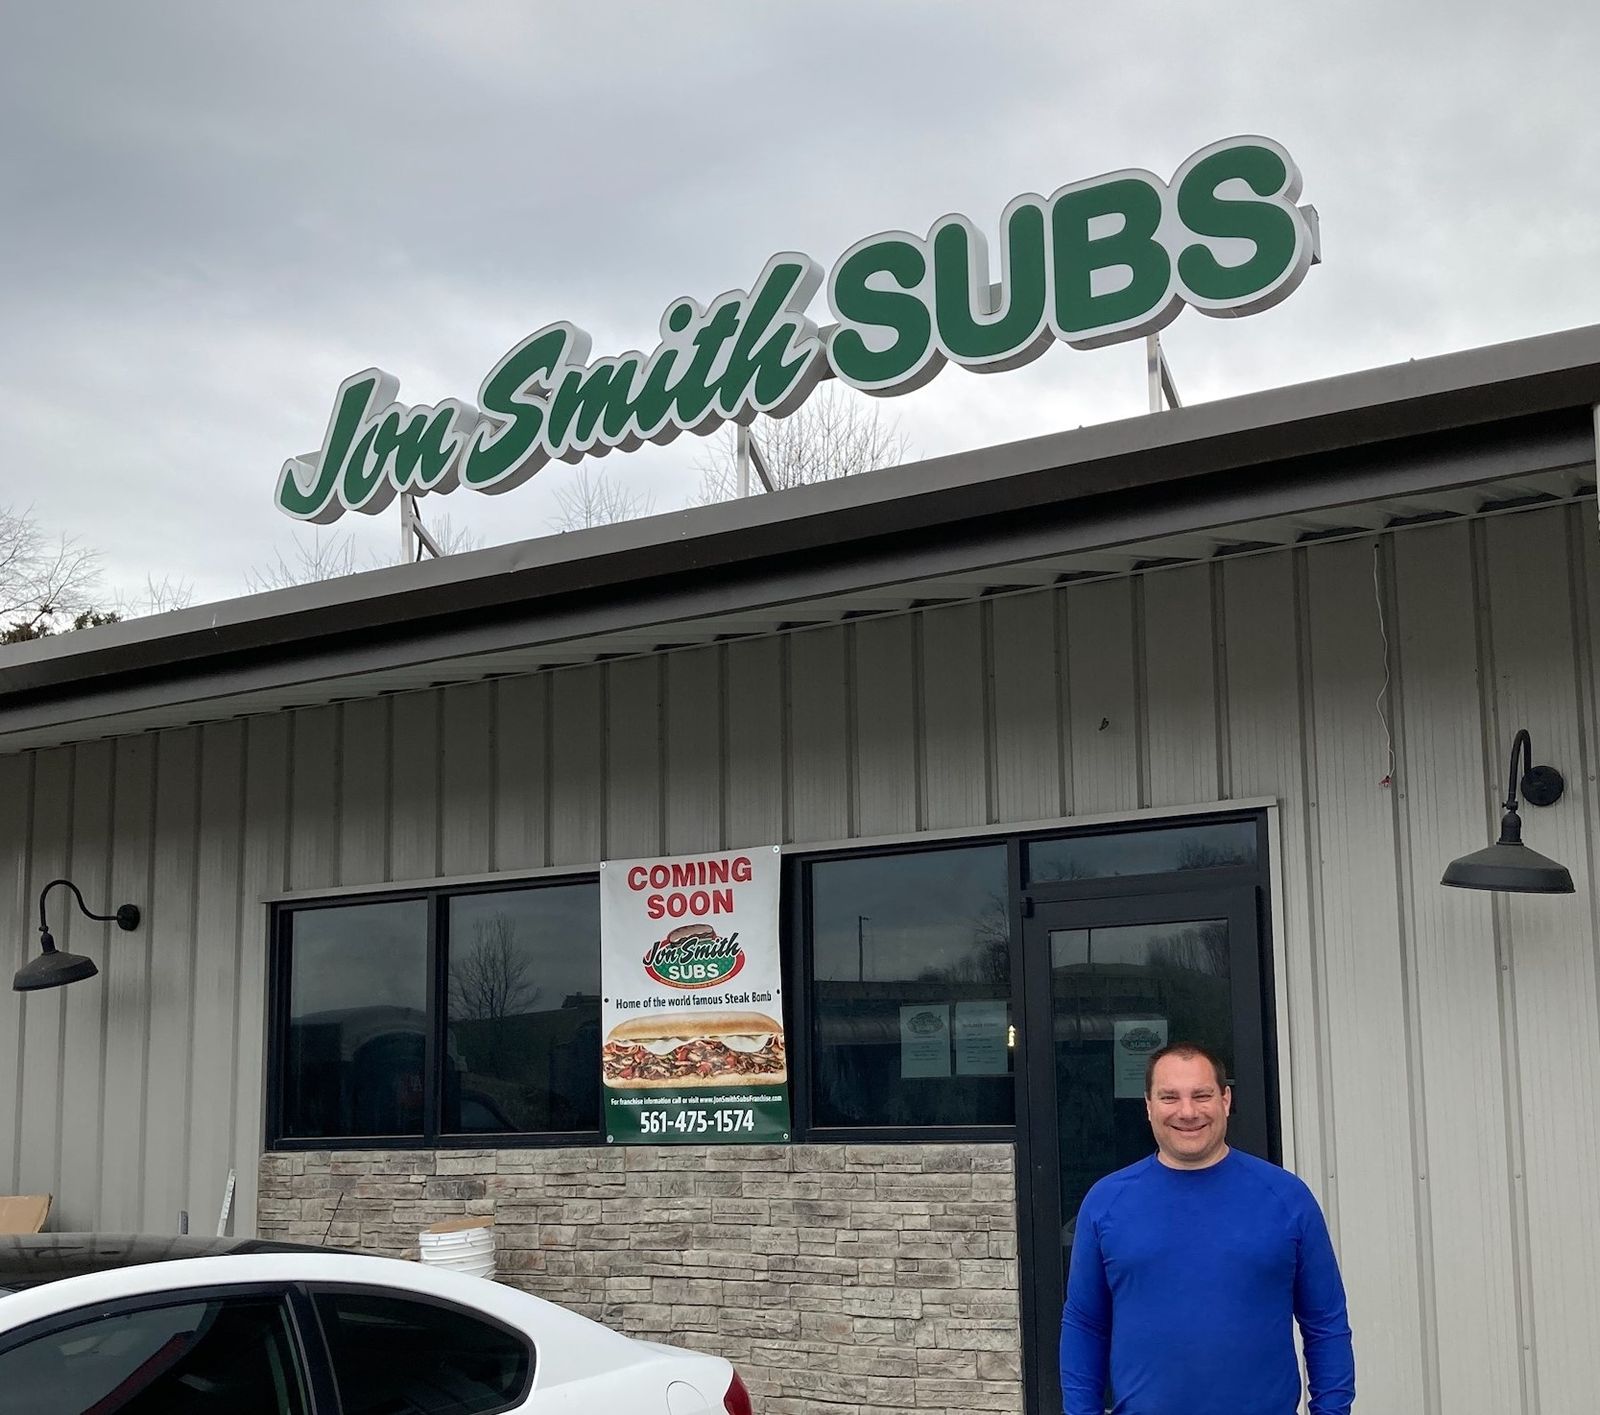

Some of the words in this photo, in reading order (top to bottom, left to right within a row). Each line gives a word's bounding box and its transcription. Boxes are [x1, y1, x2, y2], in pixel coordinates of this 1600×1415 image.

[278, 376, 457, 514] Jon
[466, 264, 810, 484] Smith
[829, 145, 1296, 383] SUBS
[627, 856, 753, 891] COMING
[647, 888, 734, 919] SOON
[642, 941, 678, 966] Jon
[679, 932, 742, 964] Smith
[668, 963, 720, 980] SUBS
[616, 999, 641, 1009] Home
[643, 997, 652, 1007] of
[653, 996, 666, 1007] the
[668, 995, 691, 1006] world
[693, 994, 723, 1005] famous
[724, 993, 750, 1004] Steak
[751, 990, 772, 1002] Bomb
[644, 1096, 671, 1105] information
[672, 1096, 681, 1104] call
[688, 1096, 699, 1104] visit
[640, 1109, 755, 1134] 561-475-1574
